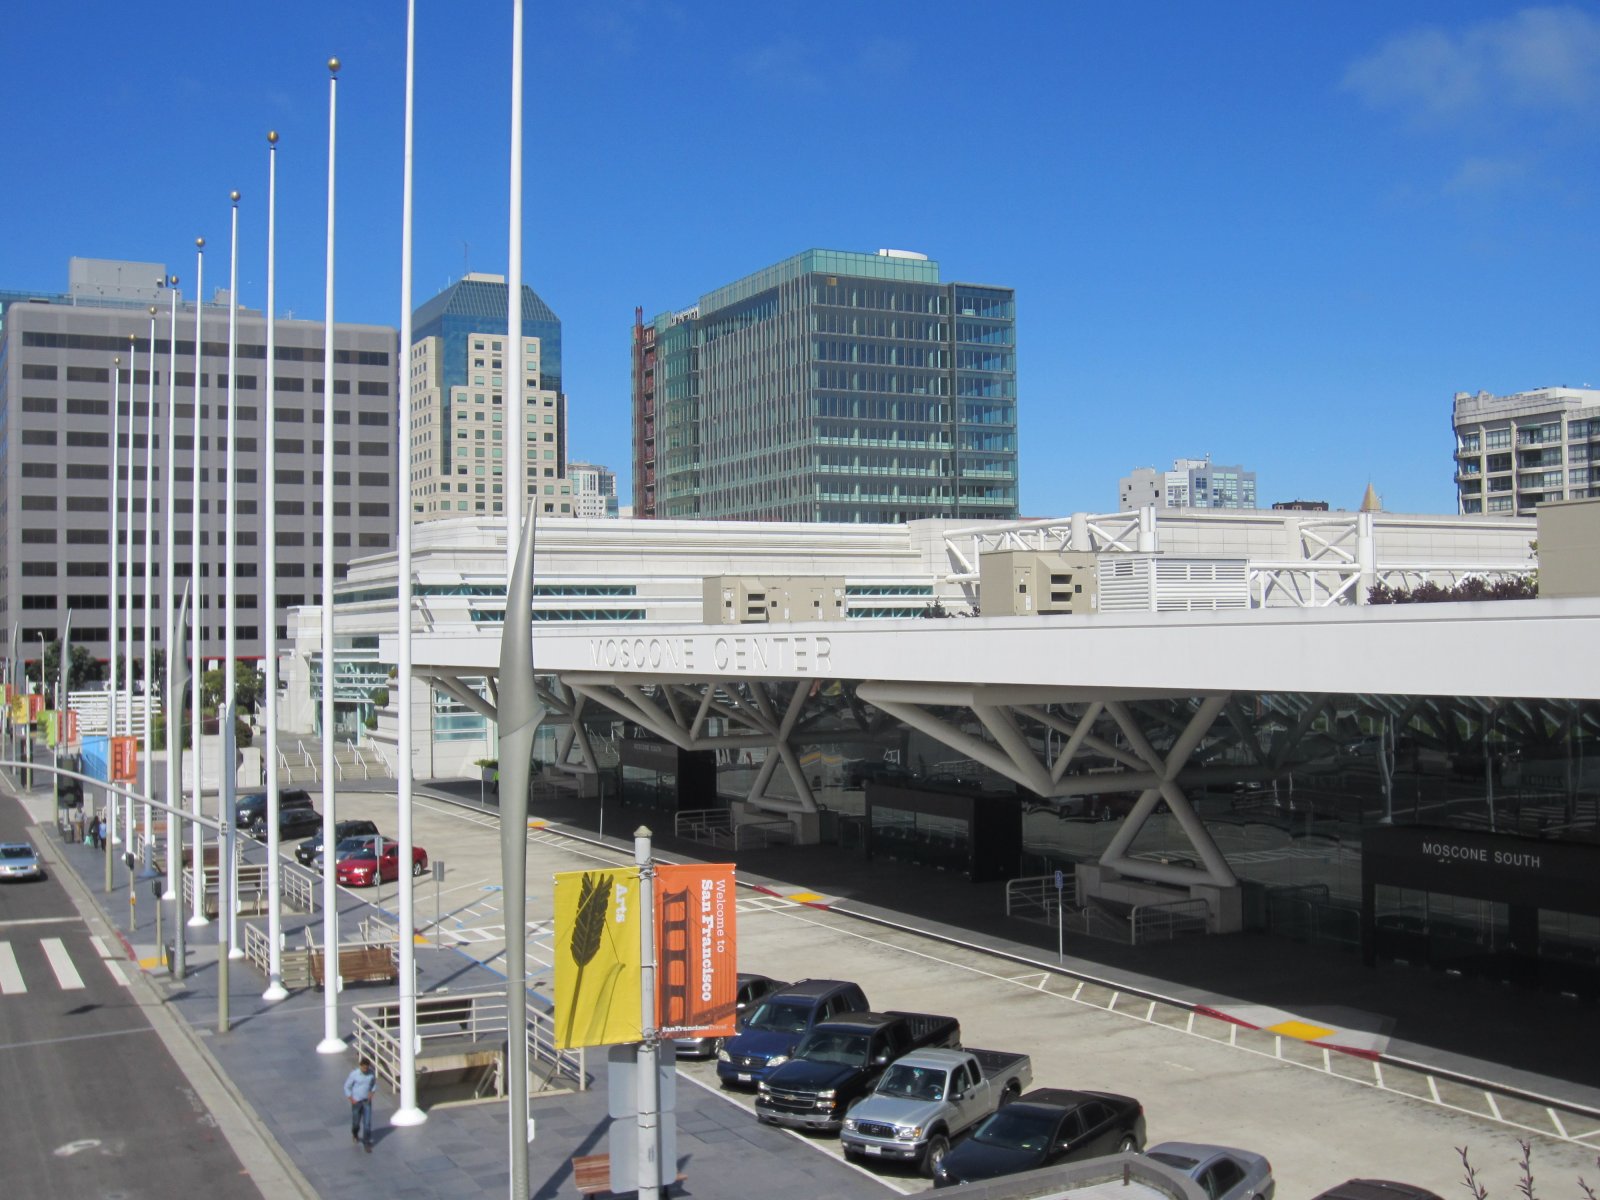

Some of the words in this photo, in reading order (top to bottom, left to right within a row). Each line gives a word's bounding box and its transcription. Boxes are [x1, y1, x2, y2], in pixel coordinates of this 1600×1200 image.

[713, 636, 832, 672] CENTER
[1422, 842, 1487, 861] MOSCONE
[1494, 851, 1540, 868] SOUTH
[615, 884, 628, 923] Arts
[701, 879, 713, 912] San
[716, 880, 725, 936] Welcome
[701, 914, 713, 1002] Francisco
[716, 941, 725, 952] to
